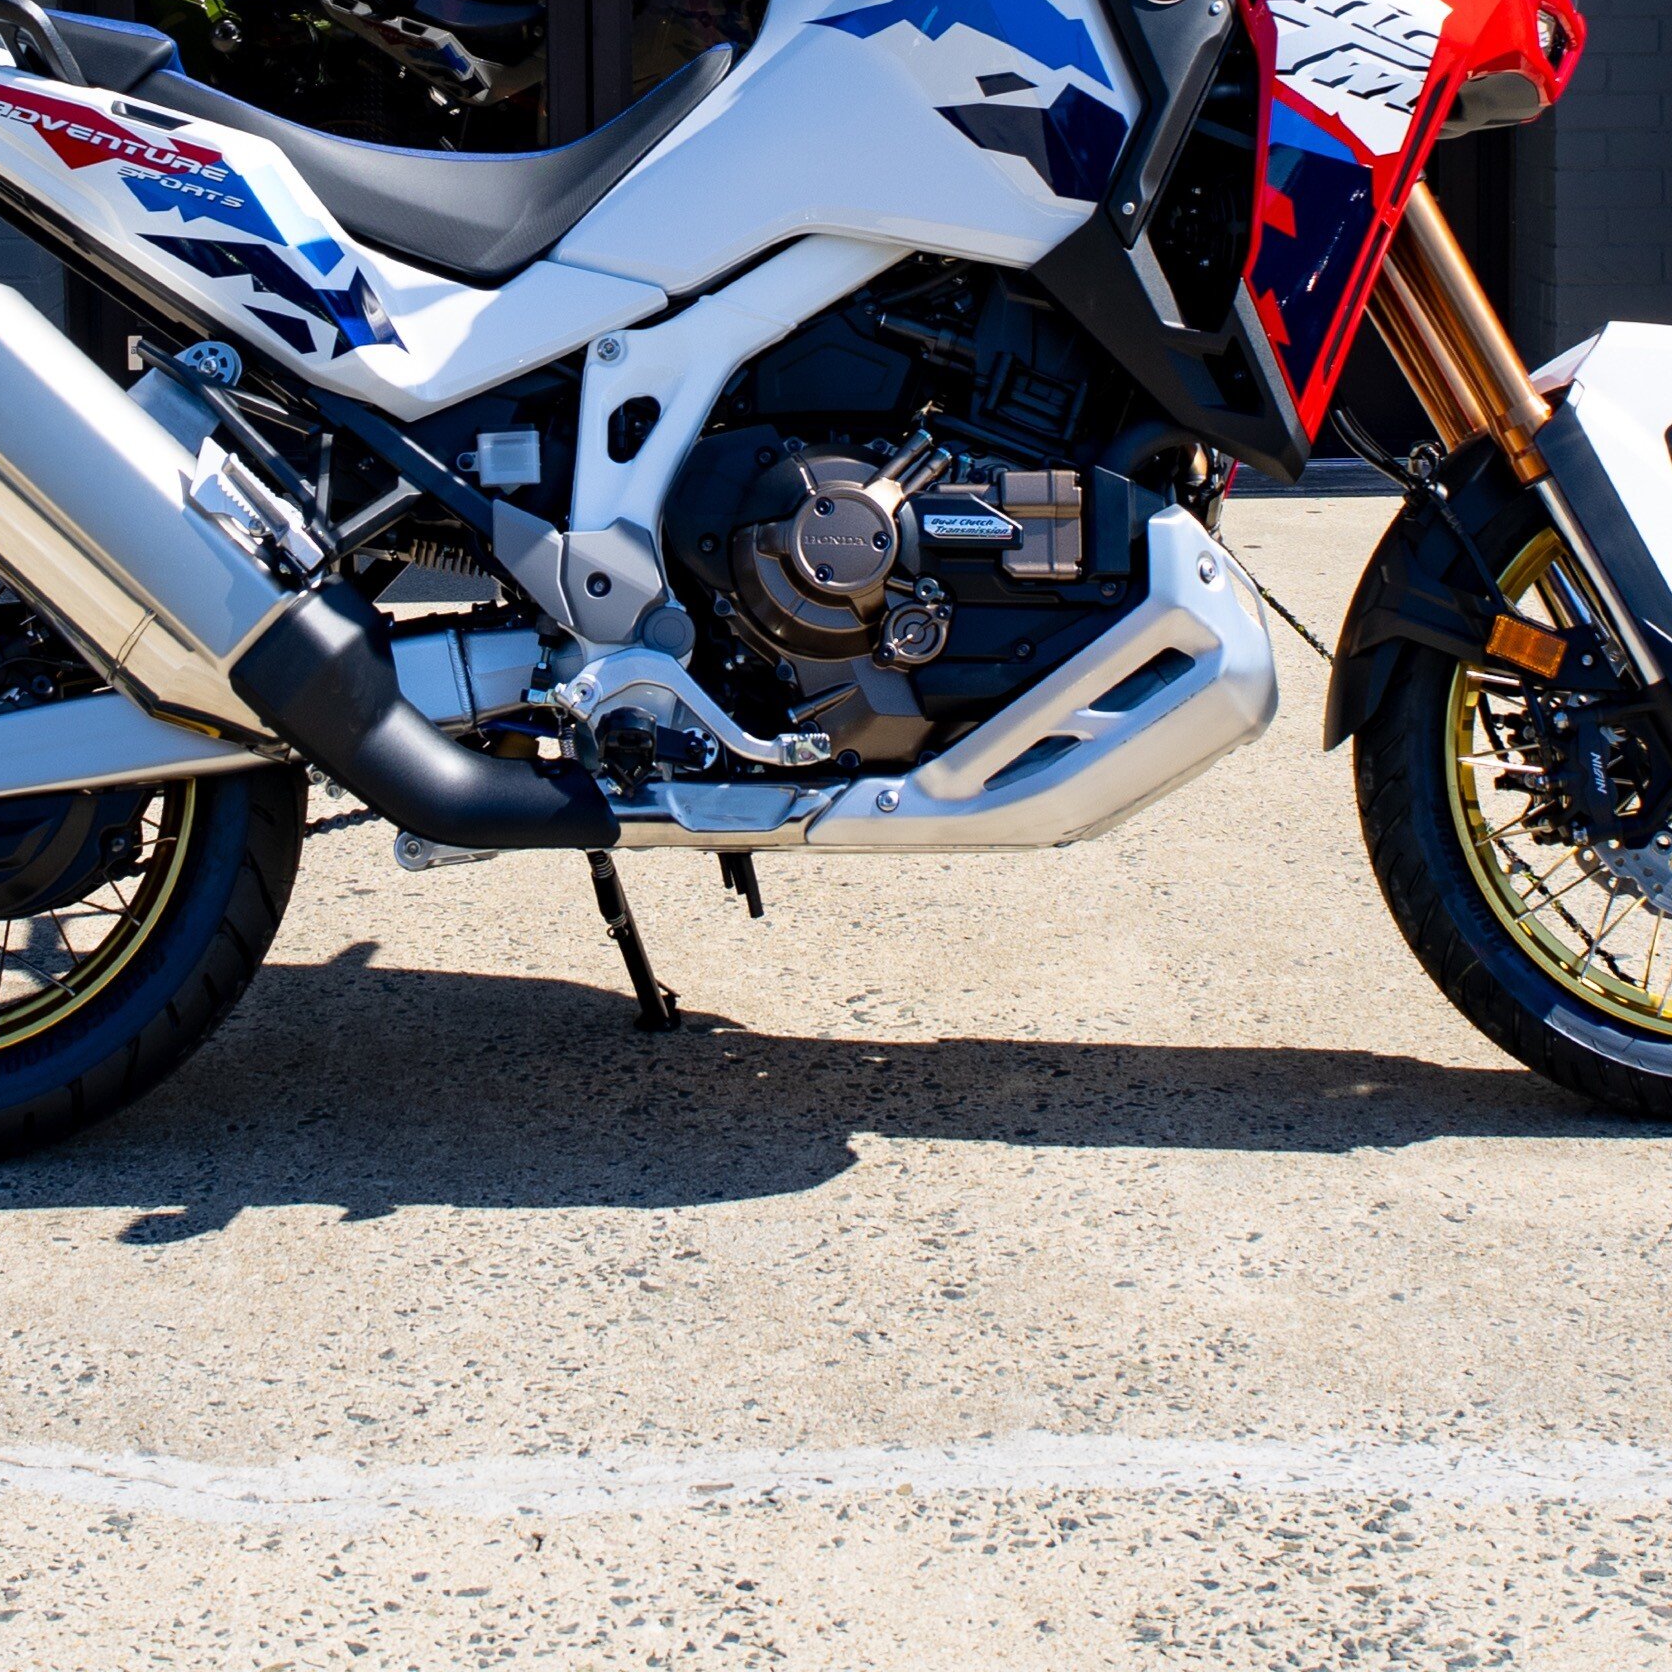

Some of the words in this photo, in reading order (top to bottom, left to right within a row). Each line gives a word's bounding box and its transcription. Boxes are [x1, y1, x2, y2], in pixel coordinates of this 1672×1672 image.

[117, 165, 246, 209] SPORTS
[959, 518, 994, 526] Clutch
[935, 526, 1009, 534] Transmission
[803, 535, 869, 547] HONDA
